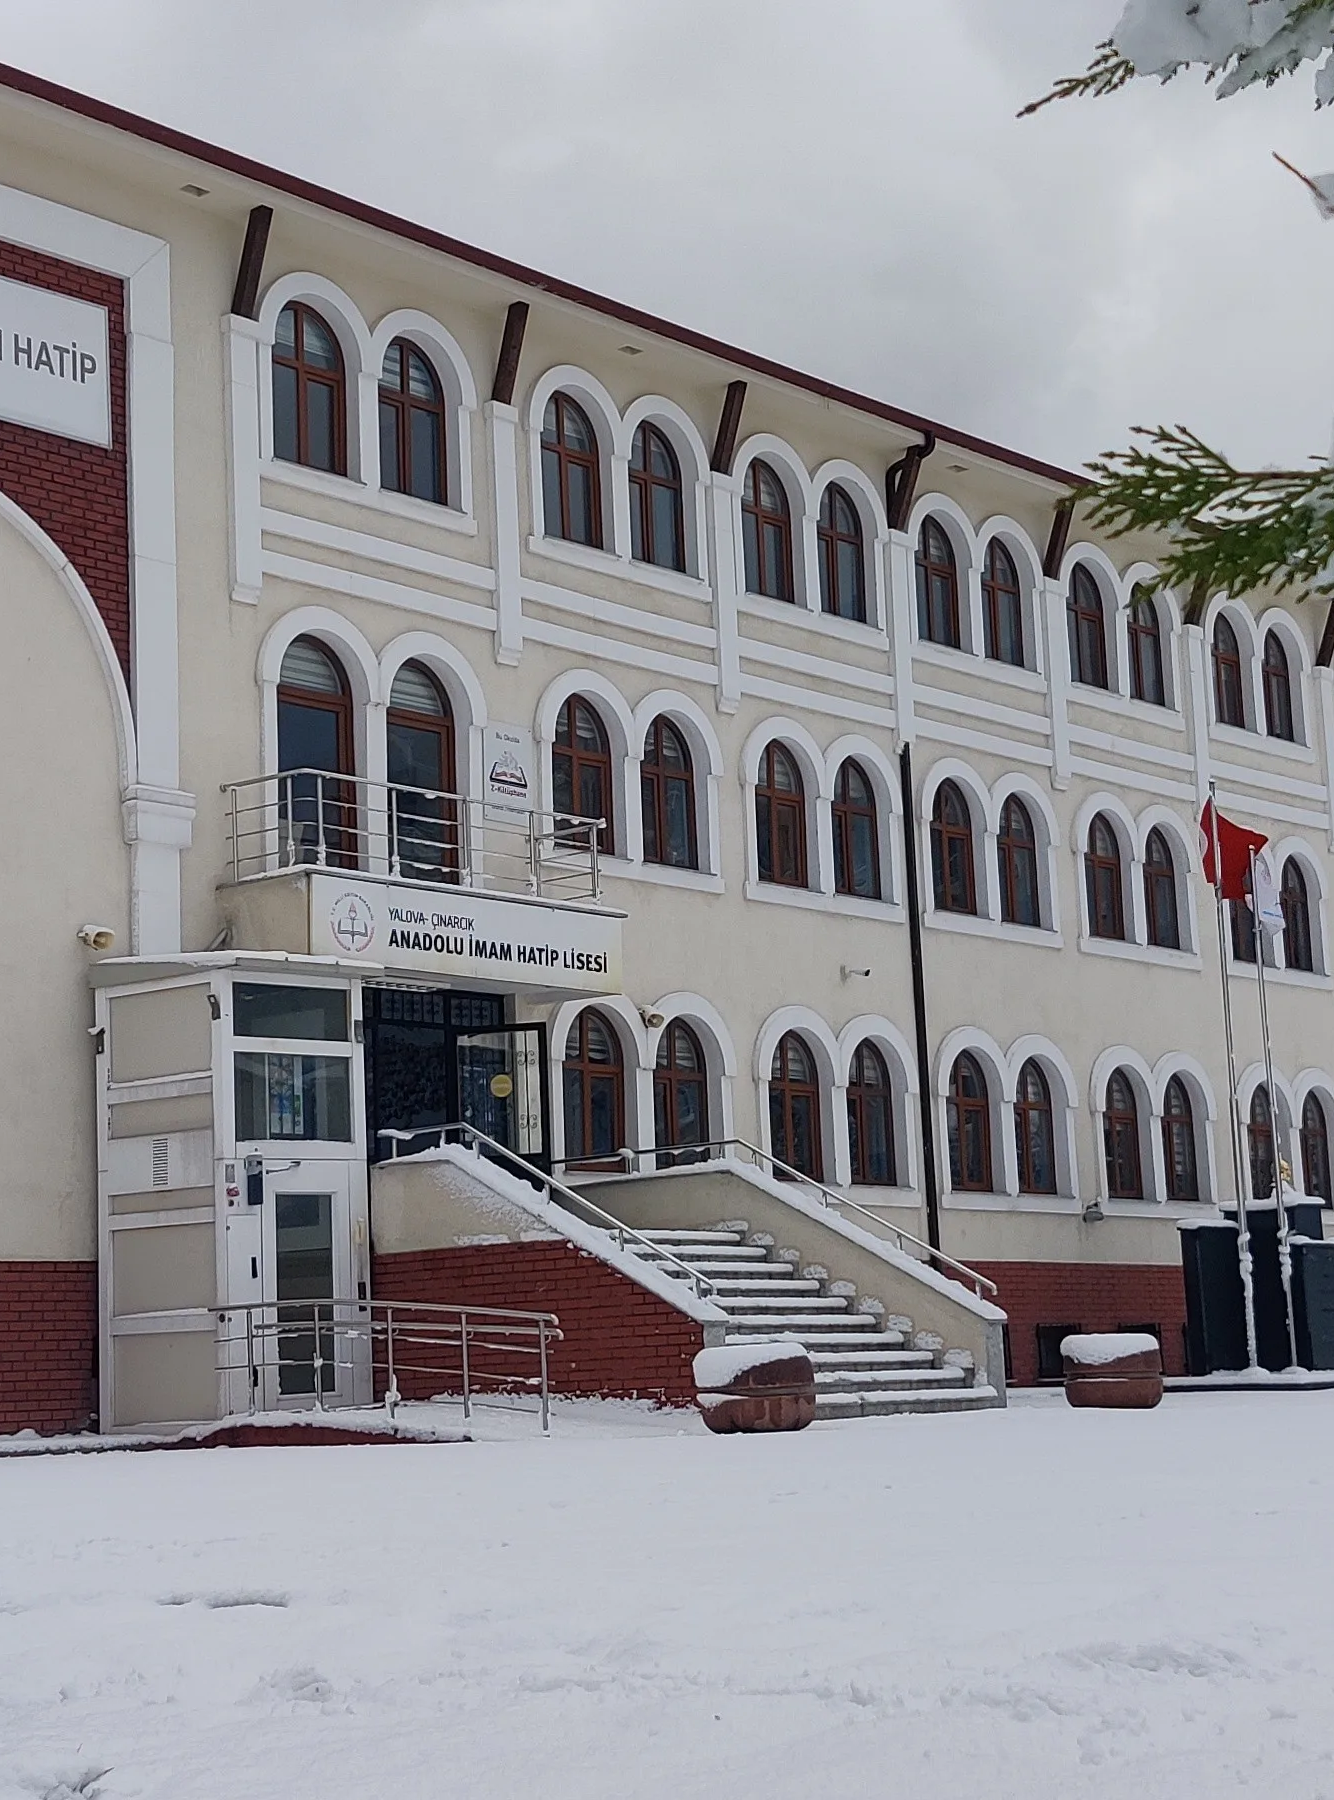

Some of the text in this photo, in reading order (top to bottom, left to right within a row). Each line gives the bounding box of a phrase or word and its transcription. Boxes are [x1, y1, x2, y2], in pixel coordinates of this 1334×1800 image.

[13, 332, 98, 384] HATİP
[431, 912, 475, 931] ÇINARCIK
[388, 928, 608, 973] ANADOLU İMAM HATİP LİSESİ
